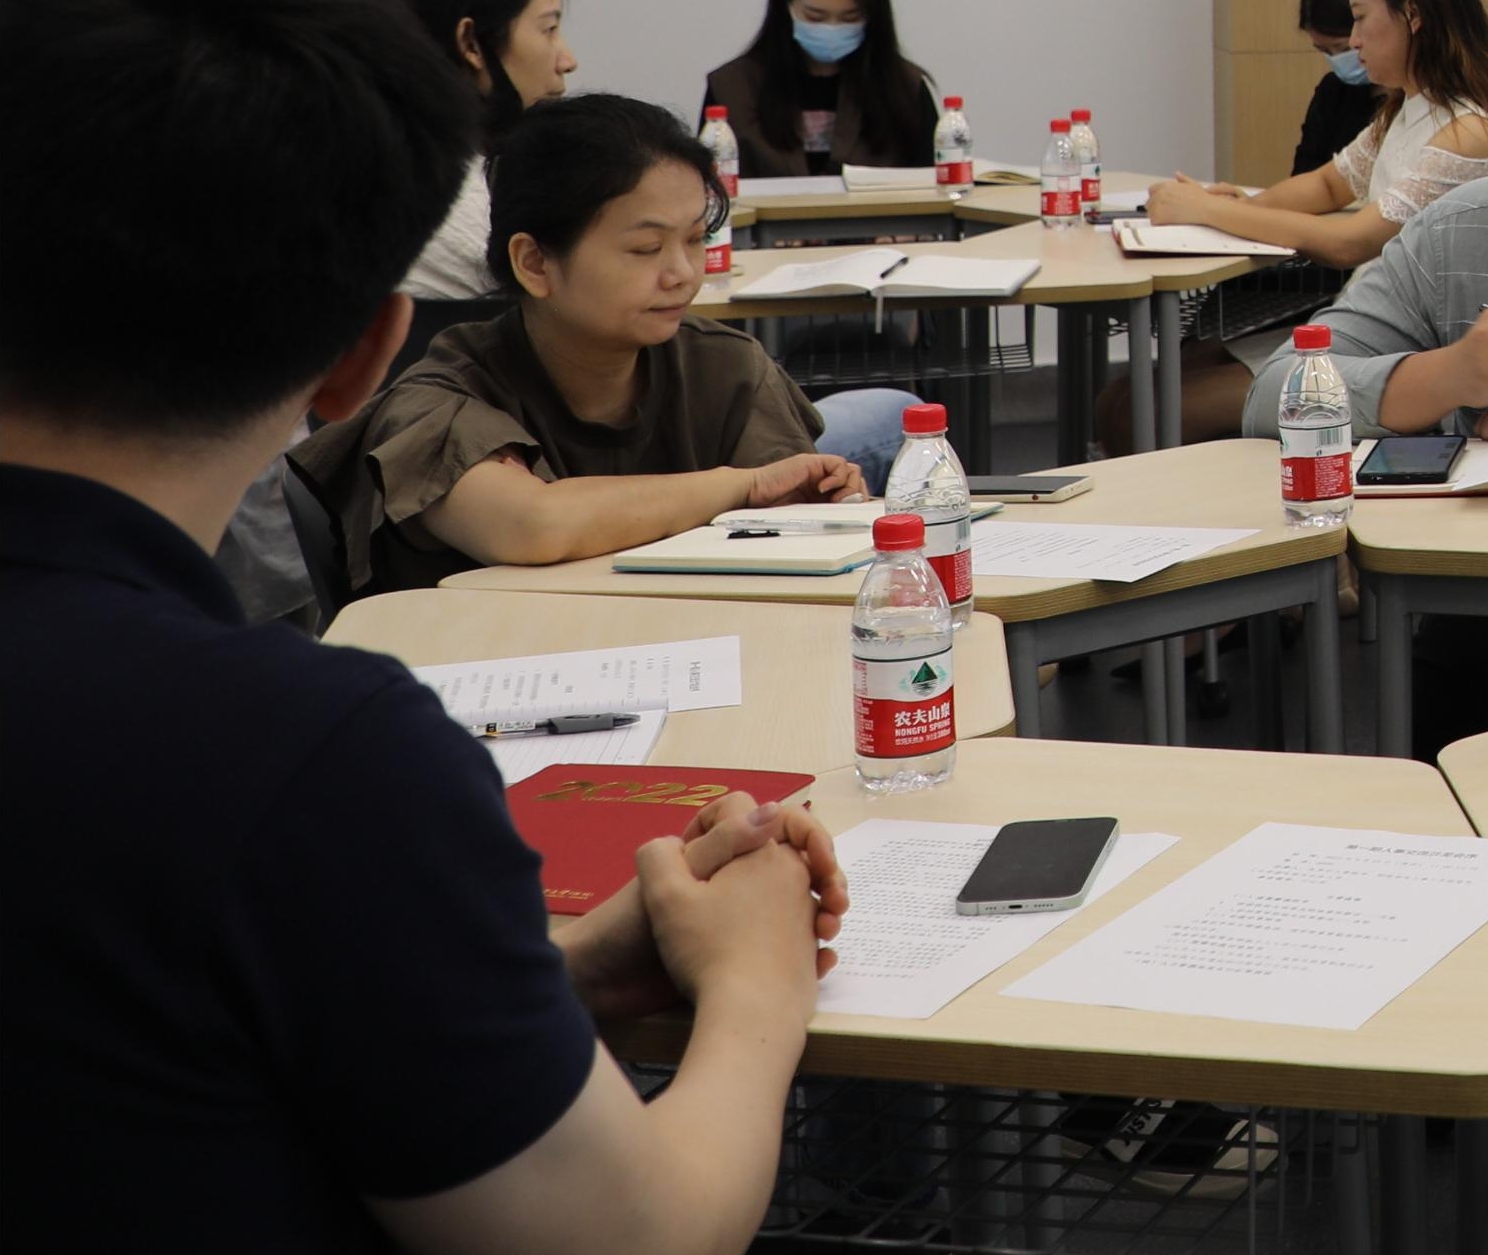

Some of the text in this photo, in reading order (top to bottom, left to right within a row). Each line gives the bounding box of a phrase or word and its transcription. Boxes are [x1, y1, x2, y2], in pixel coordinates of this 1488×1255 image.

[894, 701, 951, 728] 农夫山泉
[895, 725, 927, 737] NONGFU
